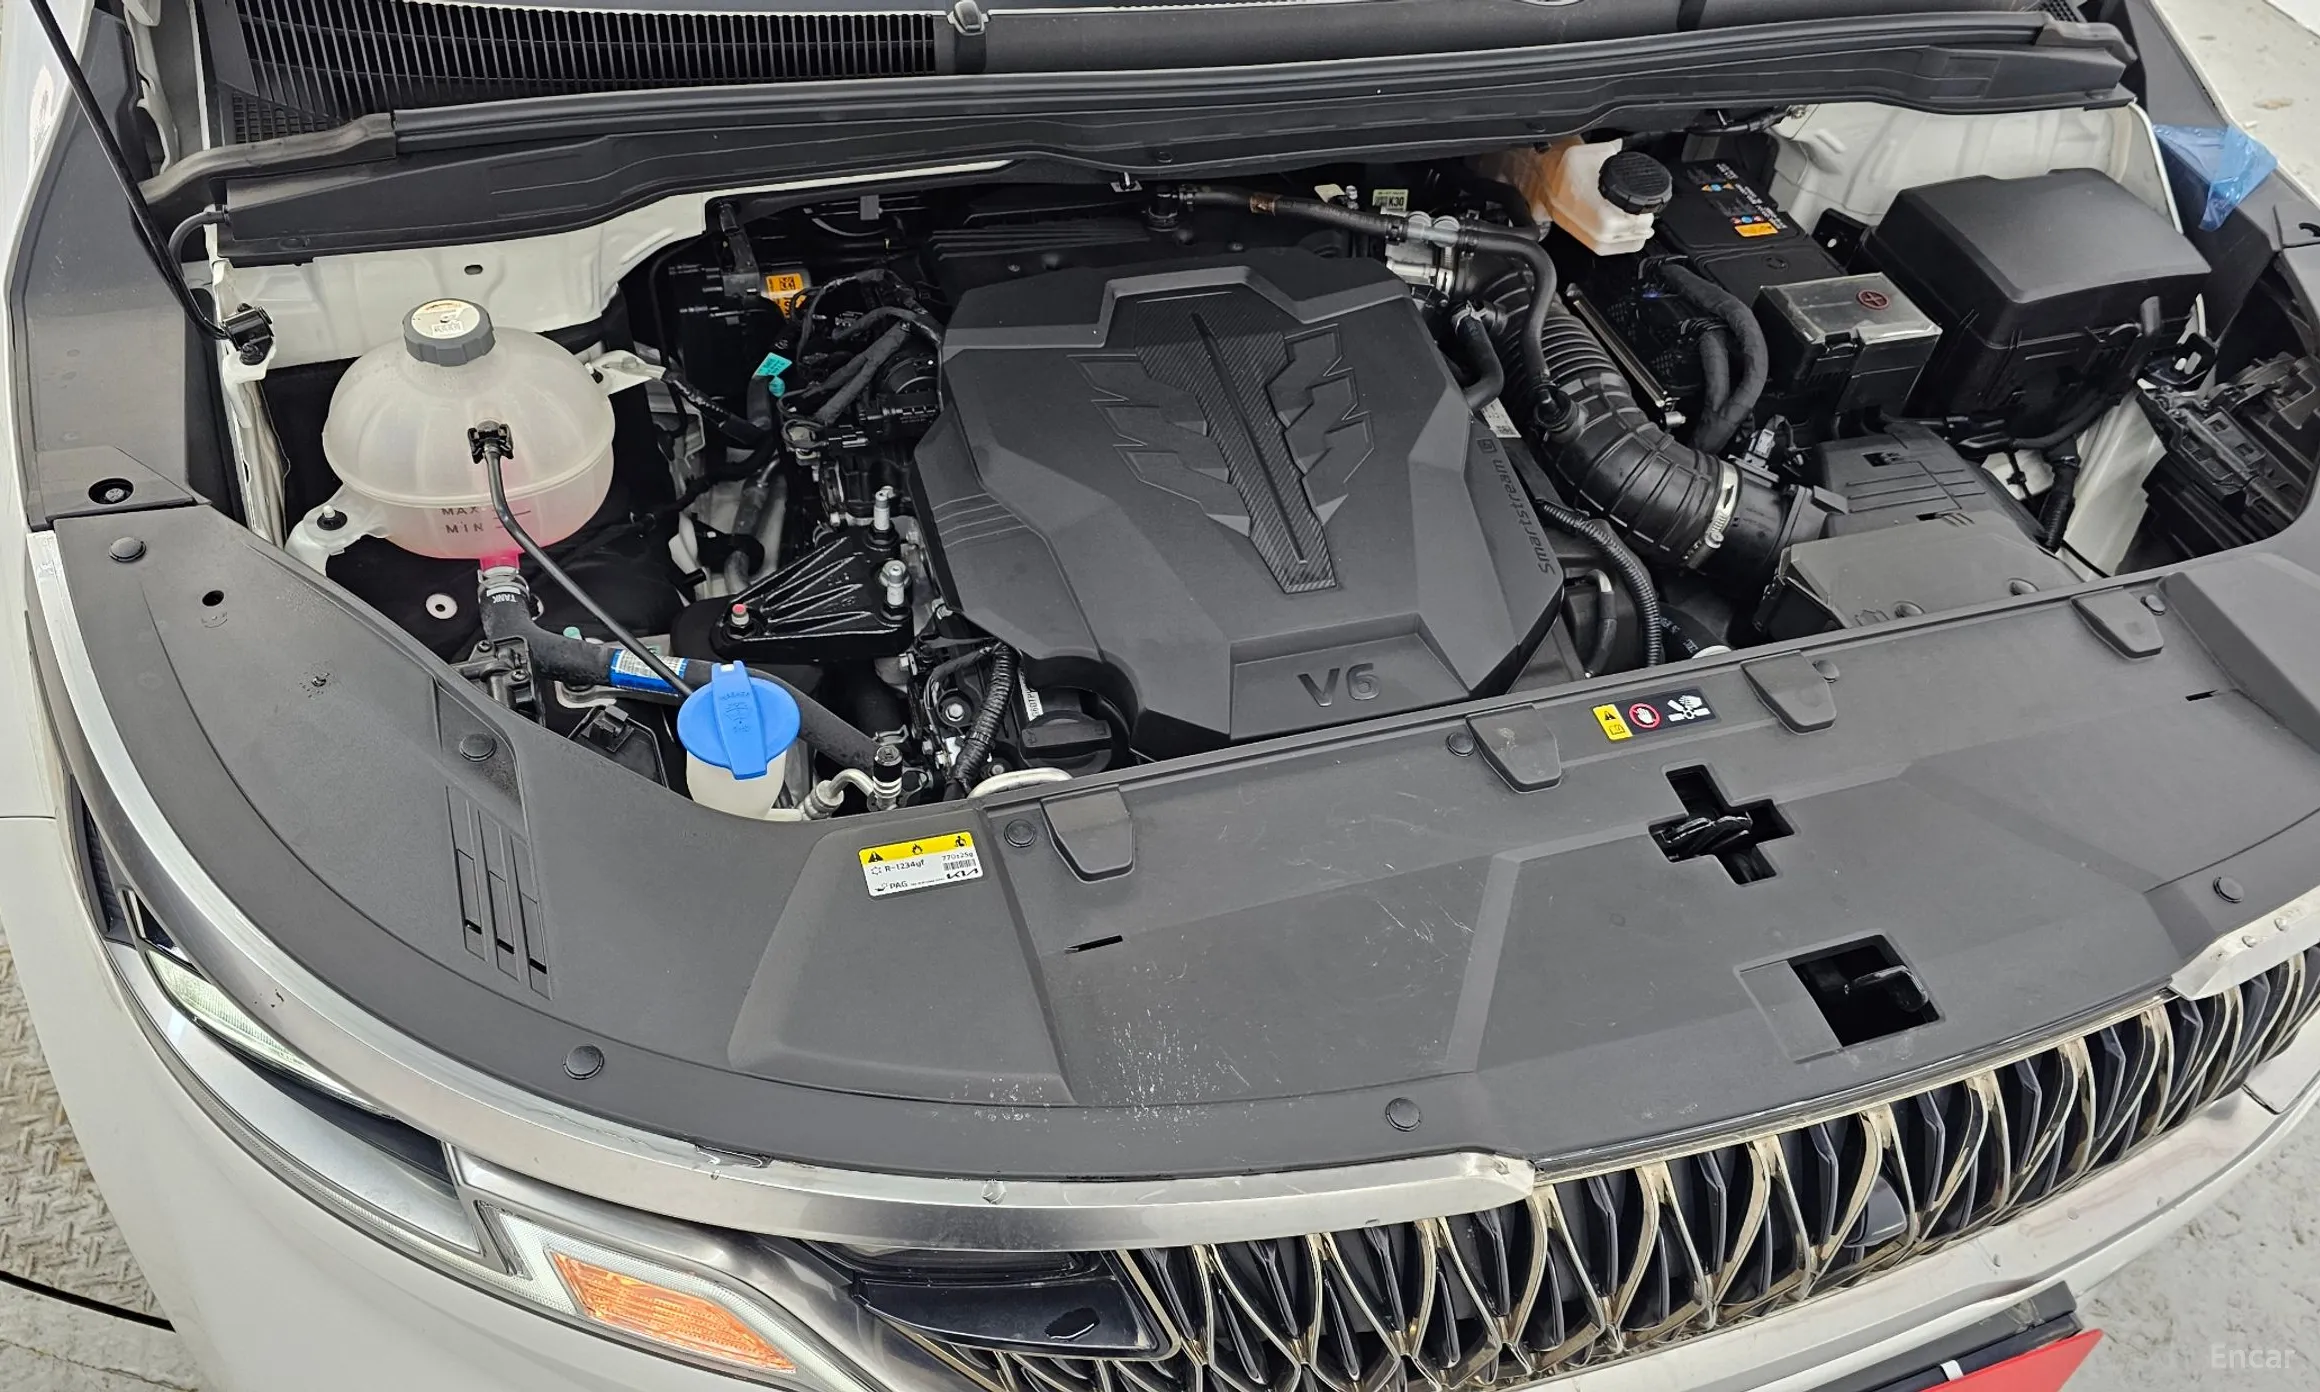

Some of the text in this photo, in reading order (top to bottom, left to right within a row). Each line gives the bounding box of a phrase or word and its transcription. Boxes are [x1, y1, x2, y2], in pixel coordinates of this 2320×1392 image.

[441, 506, 481, 516] MAX
[1492, 459, 1556, 576] Smartstream
[445, 522, 484, 534] MIN
[492, 593, 517, 604] TANK
[1297, 663, 1381, 707] V6
[884, 859, 925, 873] R-1234yf
[946, 868, 979, 880] KIA
[889, 881, 908, 890] PAG
